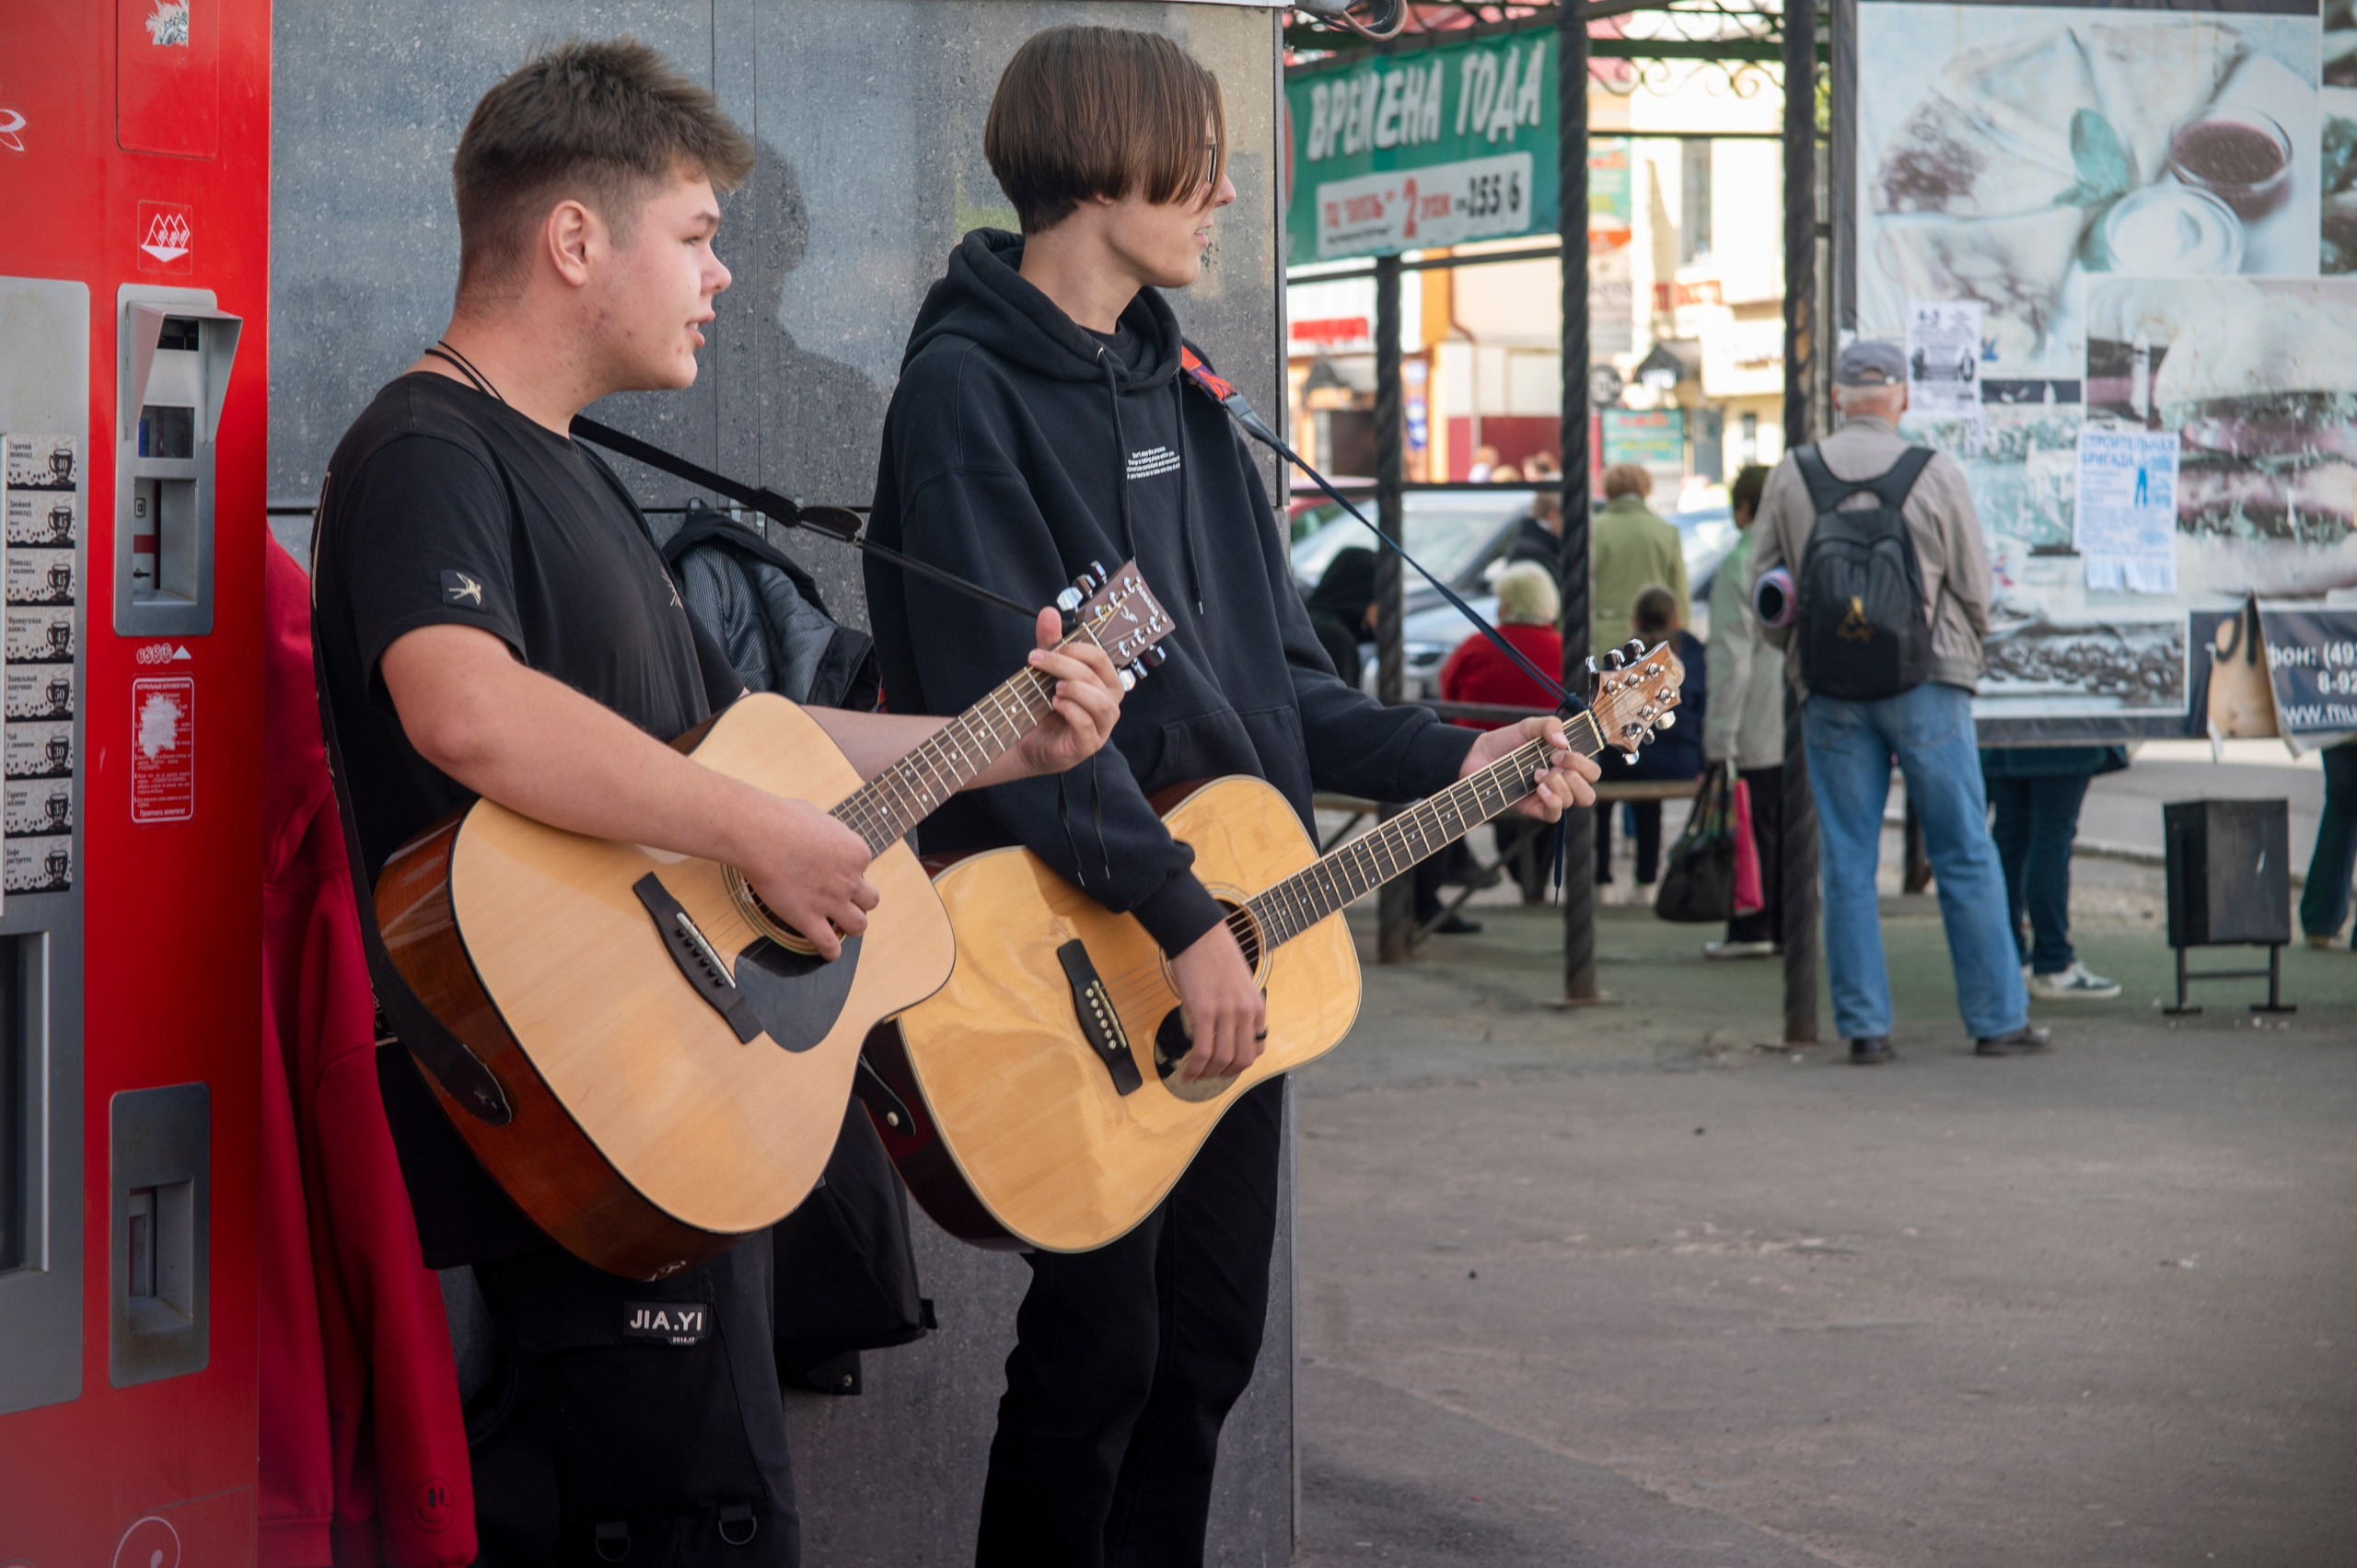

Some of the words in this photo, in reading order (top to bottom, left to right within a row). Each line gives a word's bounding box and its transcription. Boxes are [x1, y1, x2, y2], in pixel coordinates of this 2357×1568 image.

[1306, 58, 1444, 161] ВРЕМЕНА
[1456, 39, 1546, 144] ГОДА
[1402, 176, 1418, 238] 2
[9, 442, 31, 451] Горячий
[57, 459, 67, 470] 40
[8, 500, 31, 509] Двойной
[57, 516, 67, 528] 45
[8, 558, 32, 567] Шоколад
[56, 573, 65, 586] 45
[56, 630, 65, 643] 45
[54, 688, 64, 700] 50
[6, 732, 17, 740] Чай
[54, 745, 64, 757] 30
[6, 791, 28, 799] Горячее
[54, 802, 64, 815] 35
[6, 847, 19, 857] Кофе
[54, 859, 64, 871] 45
[630, 1308, 702, 1331] JIA.YI
